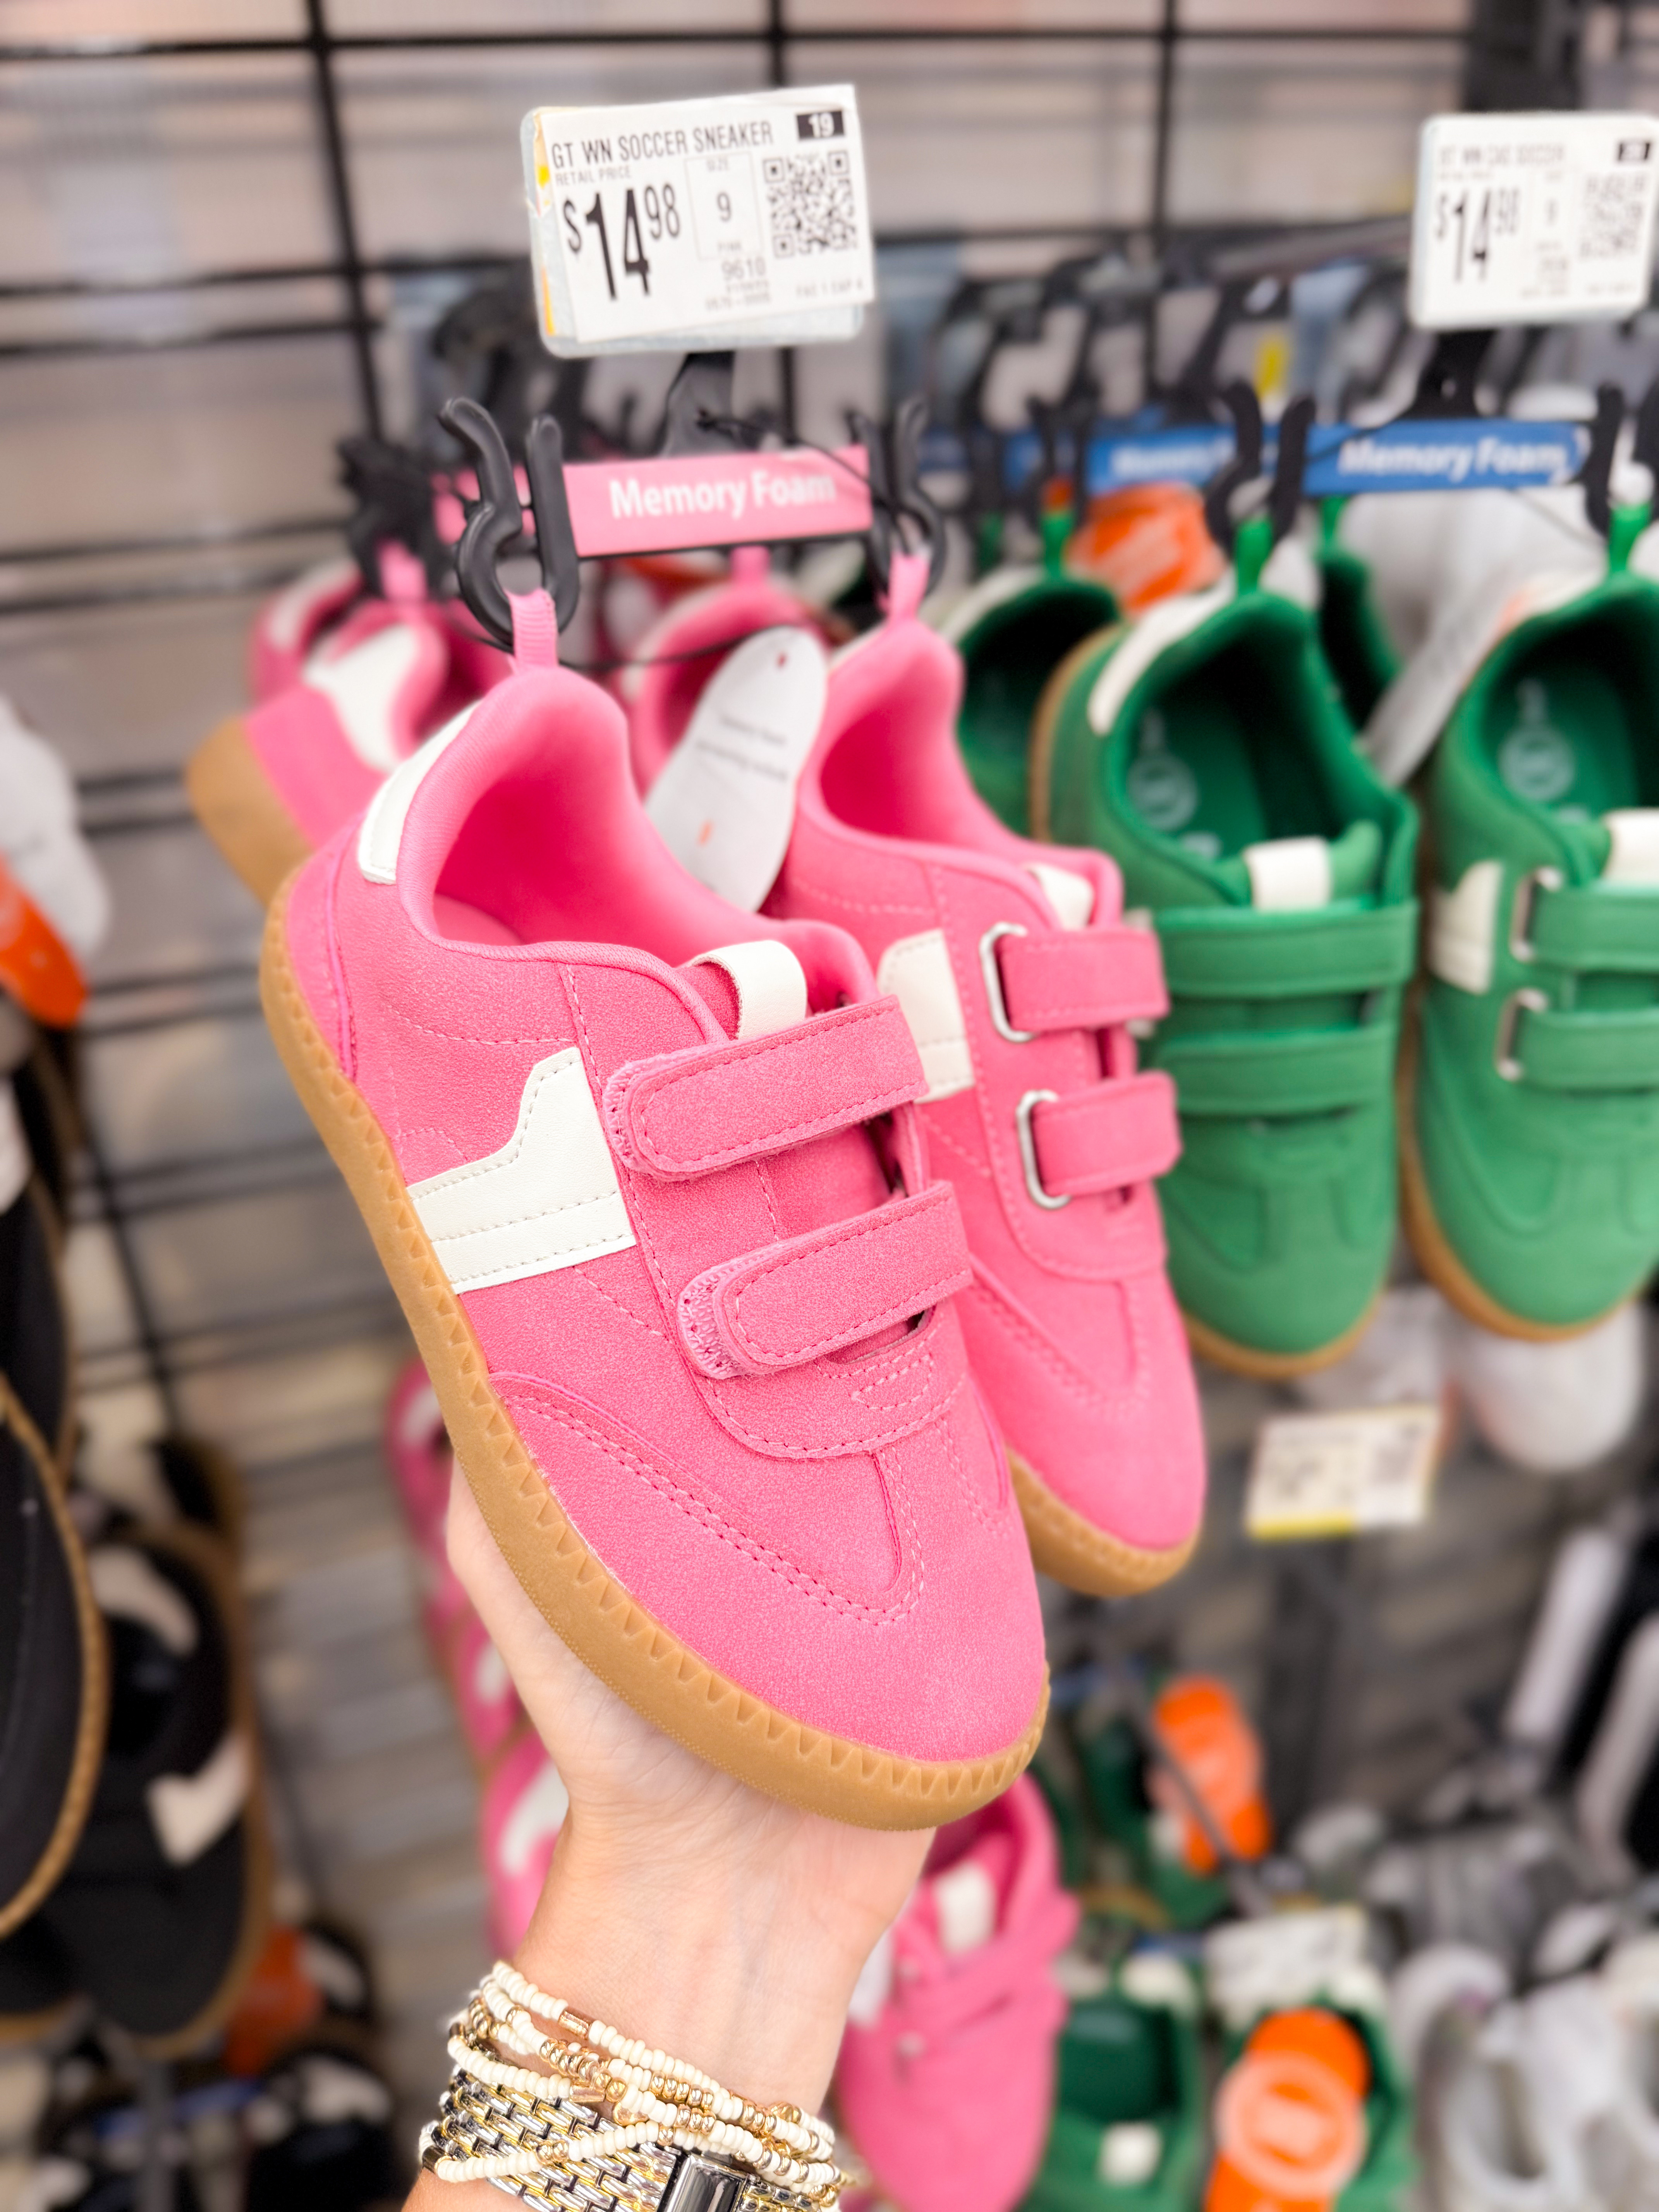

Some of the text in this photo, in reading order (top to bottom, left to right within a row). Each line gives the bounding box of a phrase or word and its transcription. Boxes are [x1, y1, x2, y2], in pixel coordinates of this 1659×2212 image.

[808, 112, 835, 138] 19
[551, 120, 774, 169] GT WN SOCCER SNEAKER
[555, 165, 632, 187] RETAIL PRICE
[716, 191, 732, 222] 9
[1338, 436, 1565, 482] Memory Foam
[609, 469, 836, 520] Memory Foam
